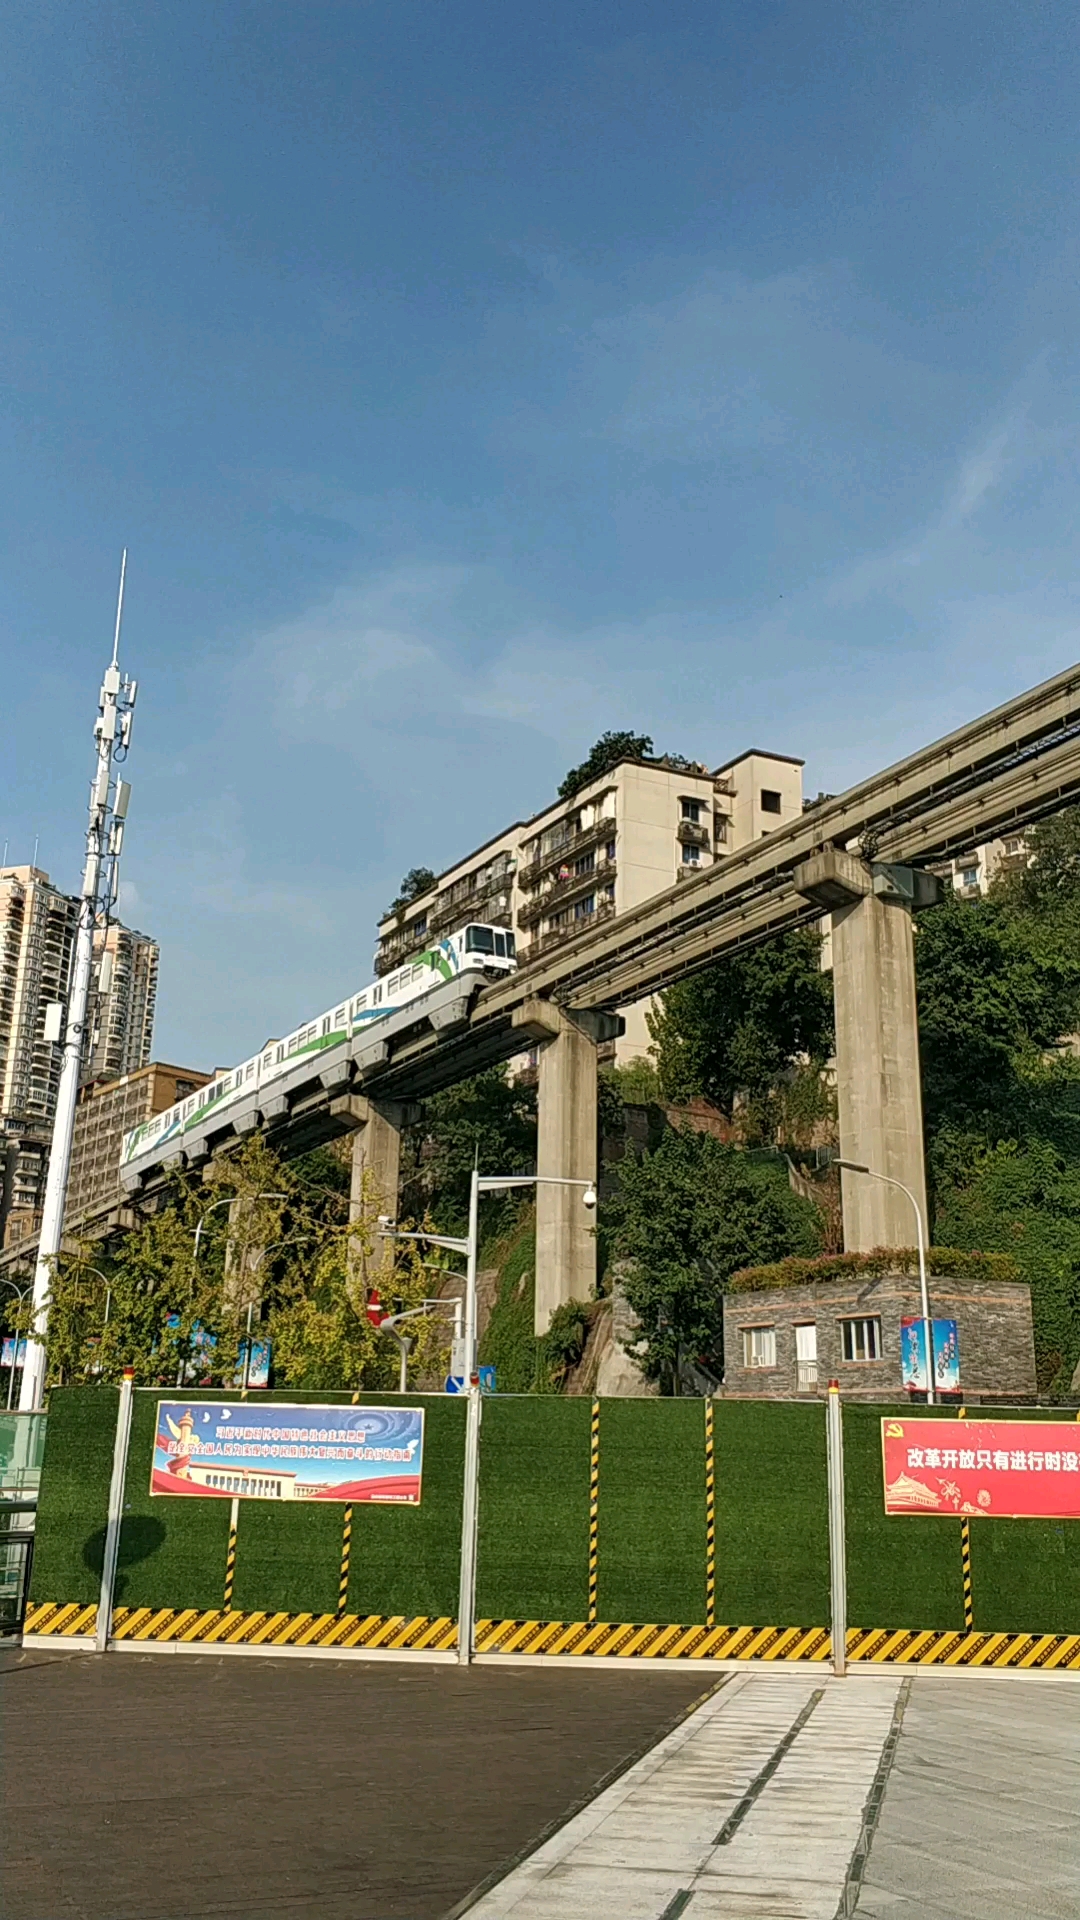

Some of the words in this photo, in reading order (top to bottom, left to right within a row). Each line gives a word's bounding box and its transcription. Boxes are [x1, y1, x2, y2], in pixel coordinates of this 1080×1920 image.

[907, 1449, 1080, 1471] 改革开放只有进行时没
